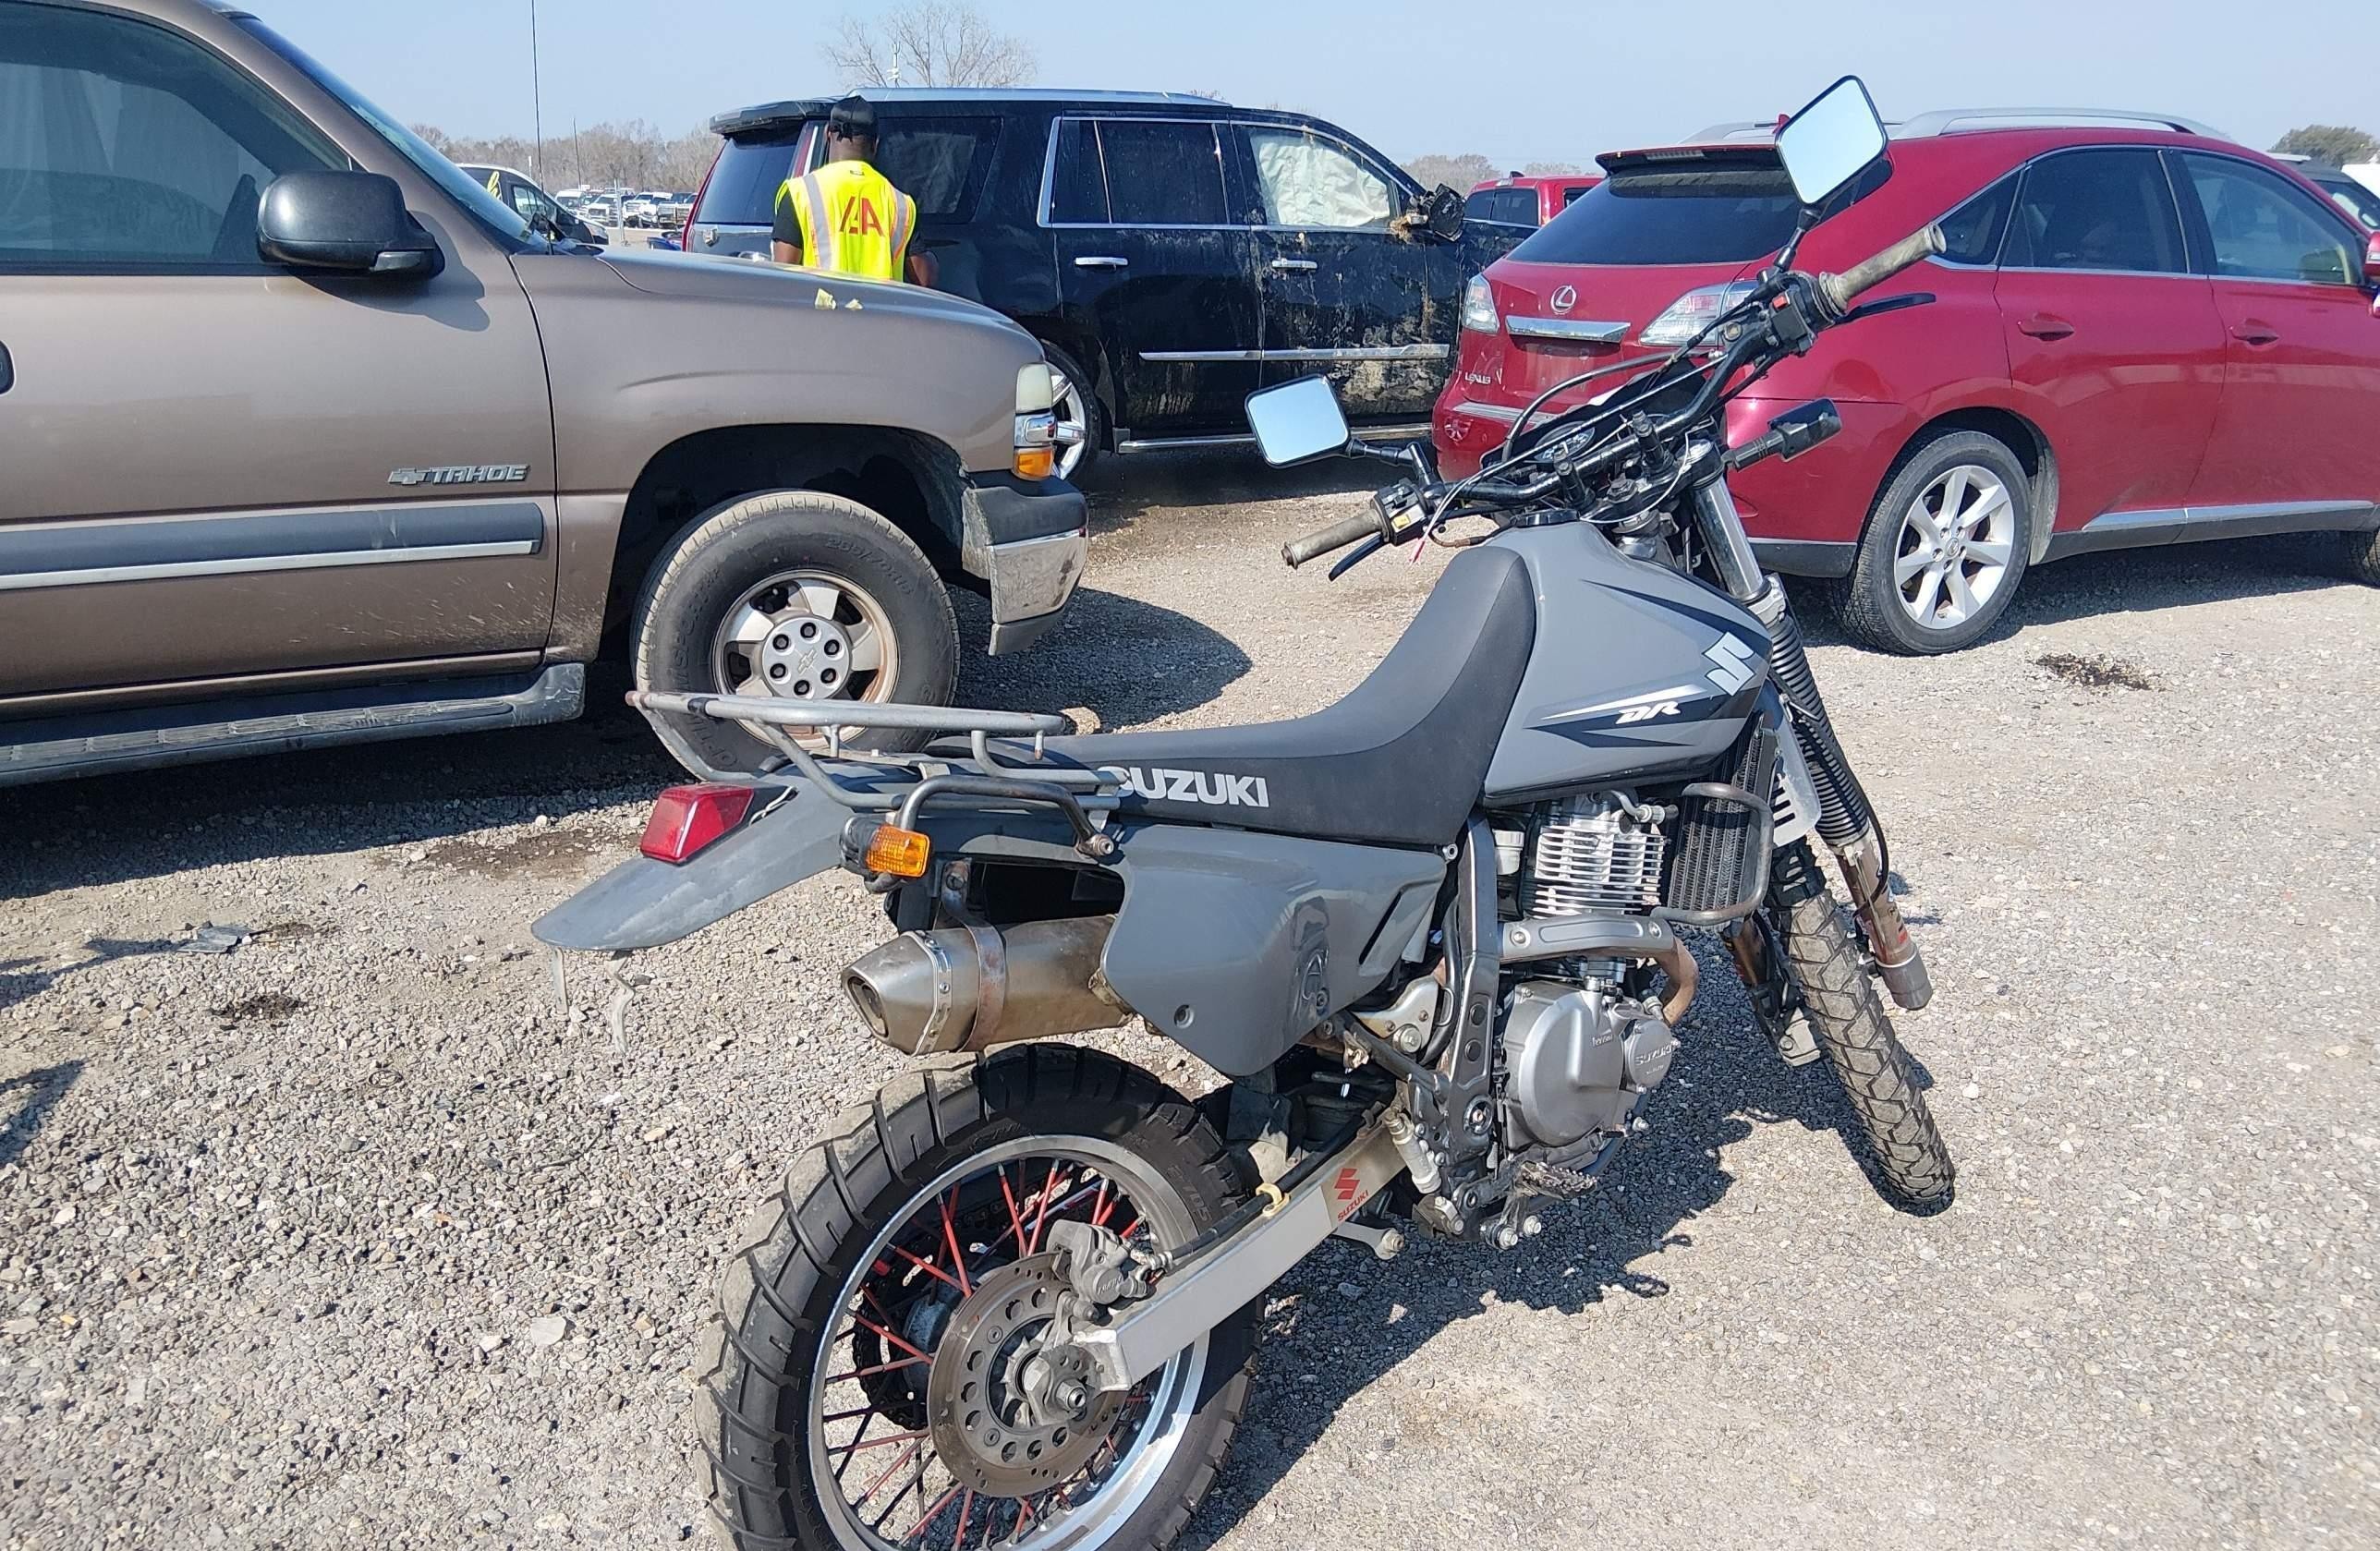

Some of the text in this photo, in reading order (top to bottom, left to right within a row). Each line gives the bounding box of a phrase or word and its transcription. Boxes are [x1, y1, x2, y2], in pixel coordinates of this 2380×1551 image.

[1464, 371, 1491, 385] LEXUS
[431, 465, 530, 485] TAHOE
[1615, 700, 1682, 725] DR
[1337, 1189, 1369, 1221] SUZUKI
